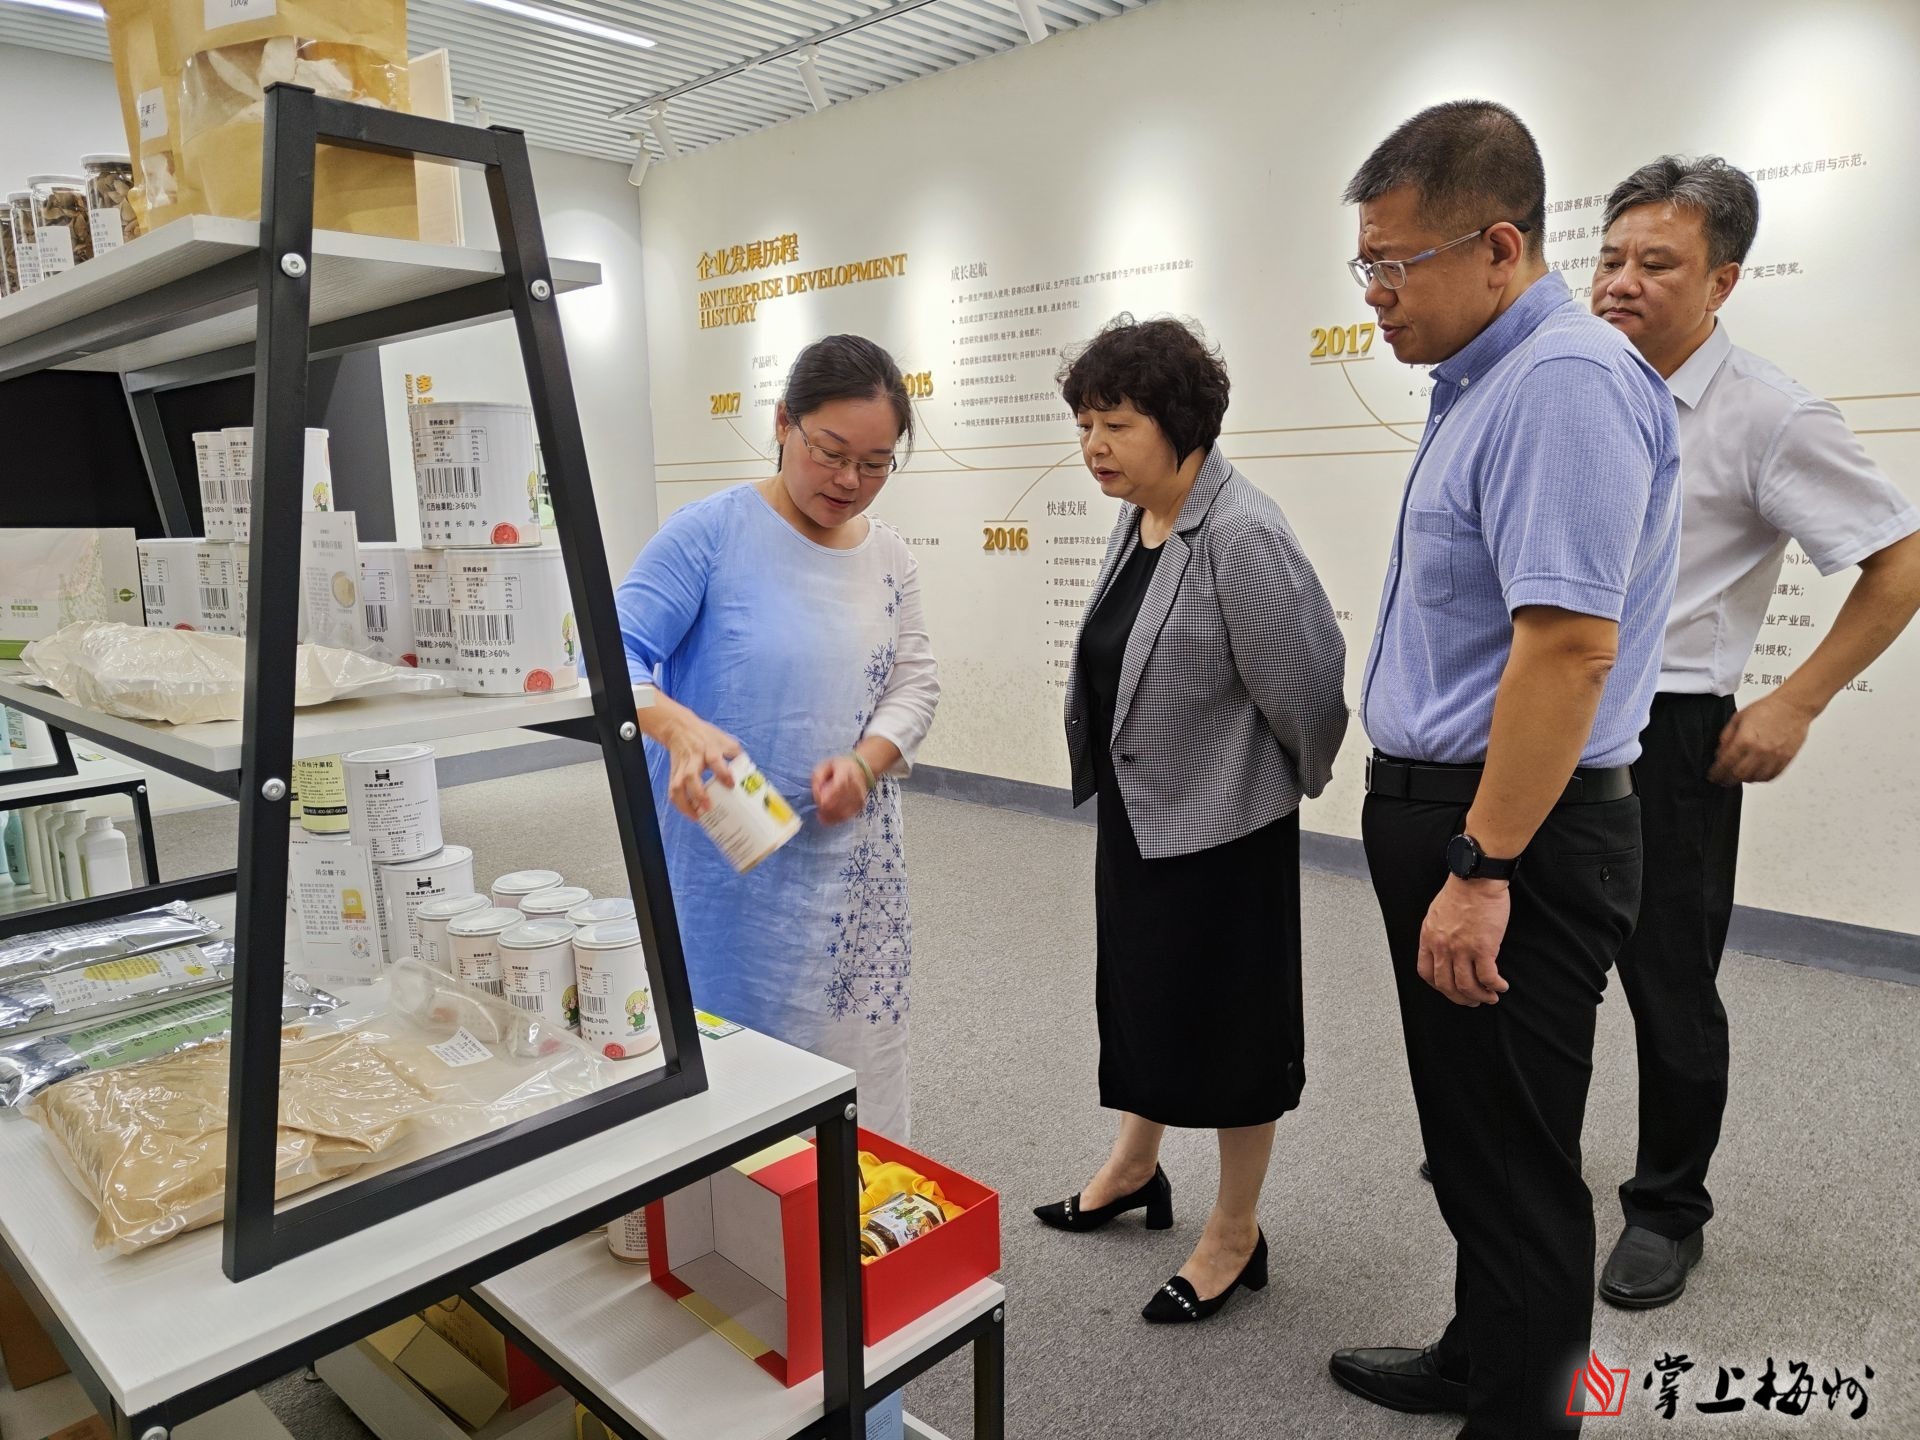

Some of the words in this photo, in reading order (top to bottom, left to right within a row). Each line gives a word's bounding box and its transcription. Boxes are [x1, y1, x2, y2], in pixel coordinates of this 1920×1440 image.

[1747, 153, 1867, 181] 首创技术应用与示范。
[1544, 225, 1606, 244] 品护肤品,并
[697, 232, 799, 281] 企业发展历程
[1547, 256, 1600, 271] 农业农村创
[699, 277, 783, 310] ENTERPRISE
[787, 254, 907, 295] DEVELOPMENT
[951, 262, 988, 281] 成长起航
[1739, 262, 1803, 280] 广奖三等奖。
[700, 303, 757, 329] HISTORY
[1310, 322, 1375, 358] 2017
[710, 392, 741, 415] 2007
[1046, 501, 1087, 516] 快速发展
[983, 527, 1028, 551] 2016
